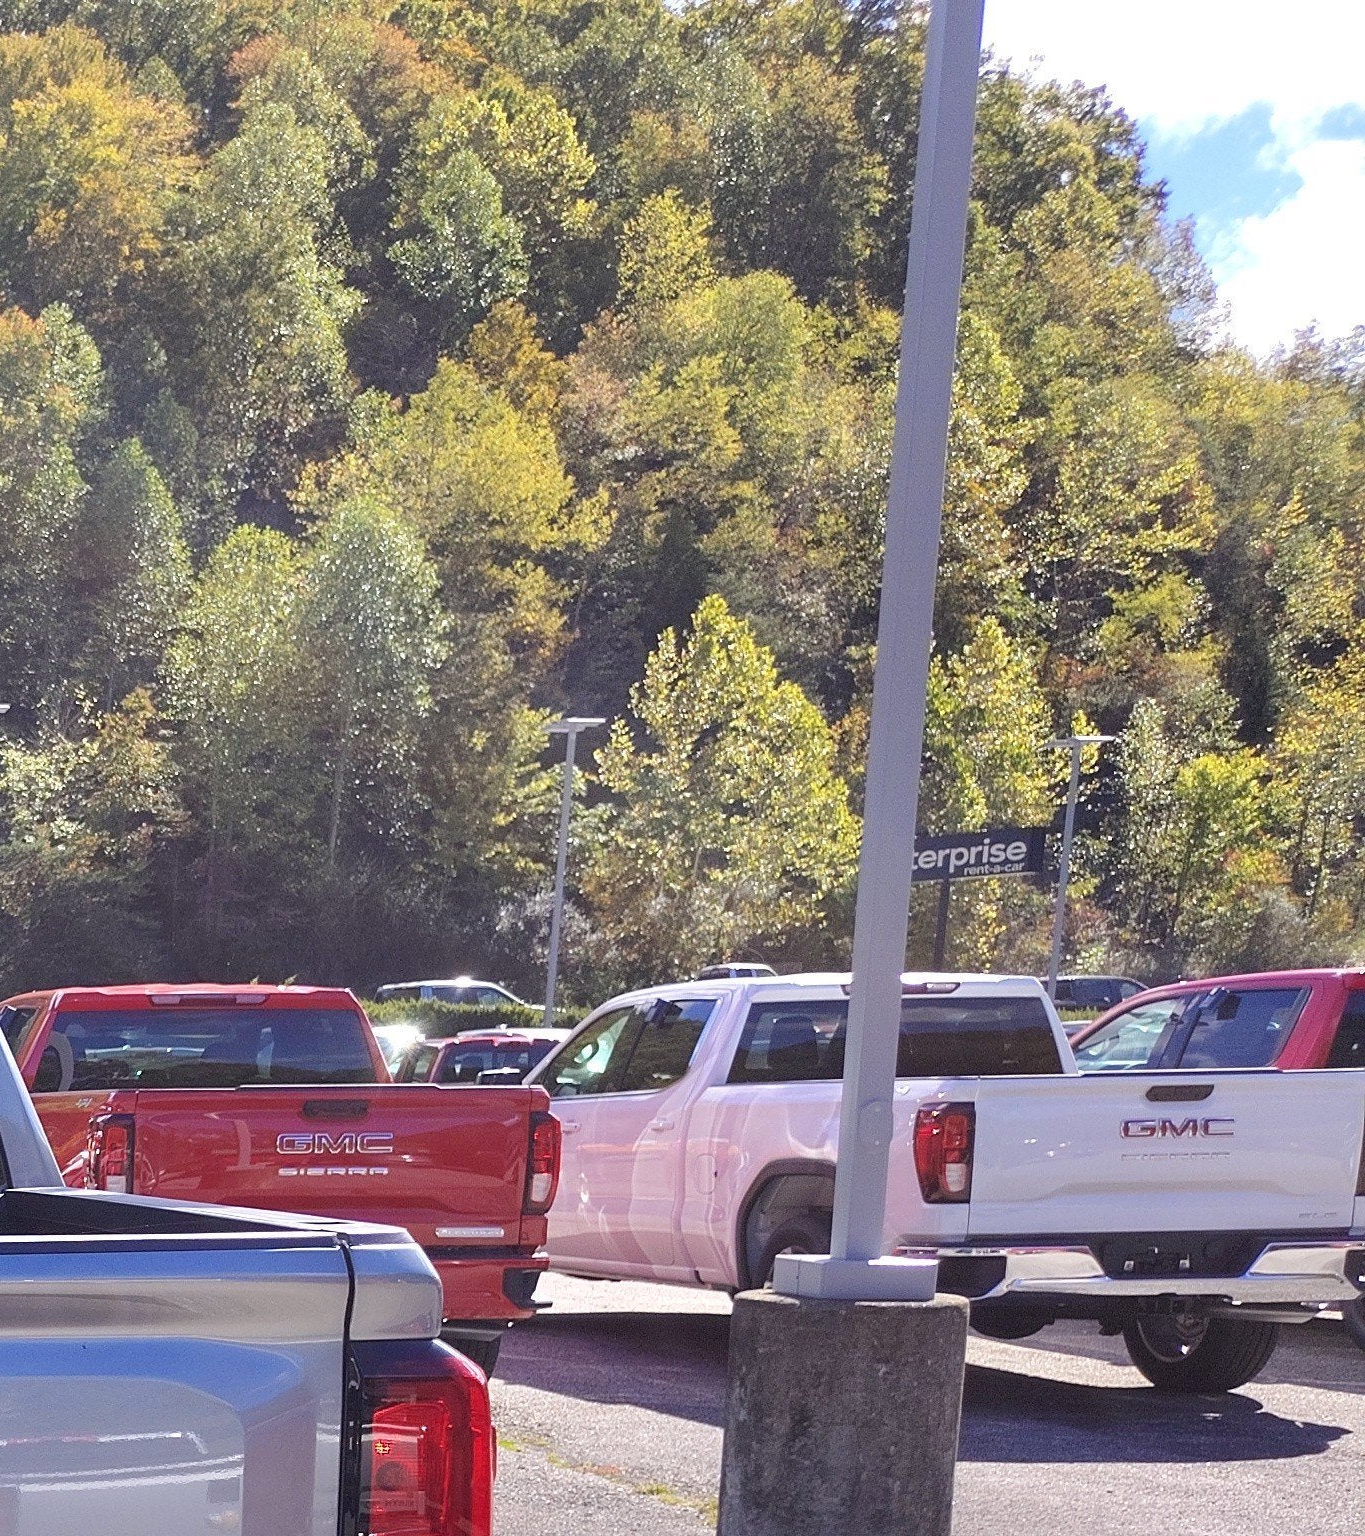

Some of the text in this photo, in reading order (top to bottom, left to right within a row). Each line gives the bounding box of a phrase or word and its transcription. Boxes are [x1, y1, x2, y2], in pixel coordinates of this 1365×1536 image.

[964, 862, 1025, 877] rent-a-car
[1120, 1117, 1235, 1139] GMC
[276, 1133, 394, 1154] GMC
[278, 1167, 389, 1176] SIERRA
